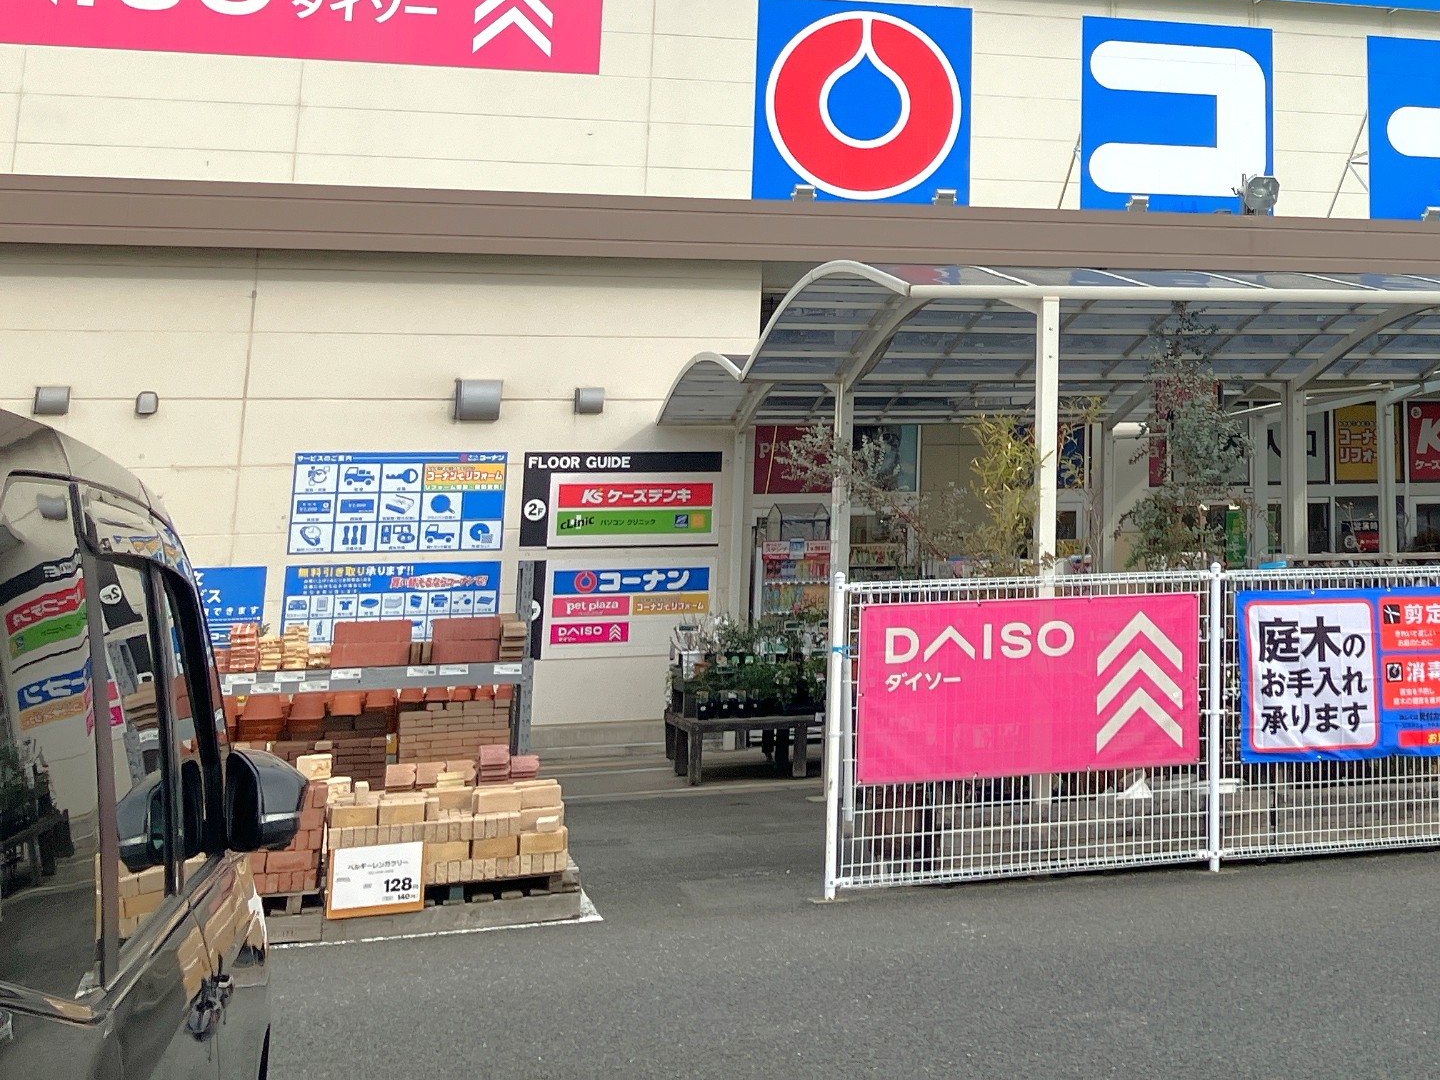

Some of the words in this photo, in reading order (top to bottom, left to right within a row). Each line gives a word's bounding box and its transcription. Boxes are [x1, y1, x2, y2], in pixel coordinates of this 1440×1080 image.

[528, 456, 580, 469] FLOOR
[586, 456, 631, 469] GUIDE
[607, 488, 691, 503] ケーズデンキ
[528, 503, 543, 516] 2F
[627, 518, 656, 526] クリニック
[599, 569, 690, 591] コーナン
[566, 603, 586, 615] pet
[588, 601, 619, 610] plaza
[558, 625, 602, 636] DAISO
[885, 620, 1075, 664] DAISO
[1259, 616, 1366, 663] 庭木の
[885, 672, 961, 692] ダイソー
[1261, 667, 1367, 697] お手入れ
[1261, 703, 1367, 734] 承ります
